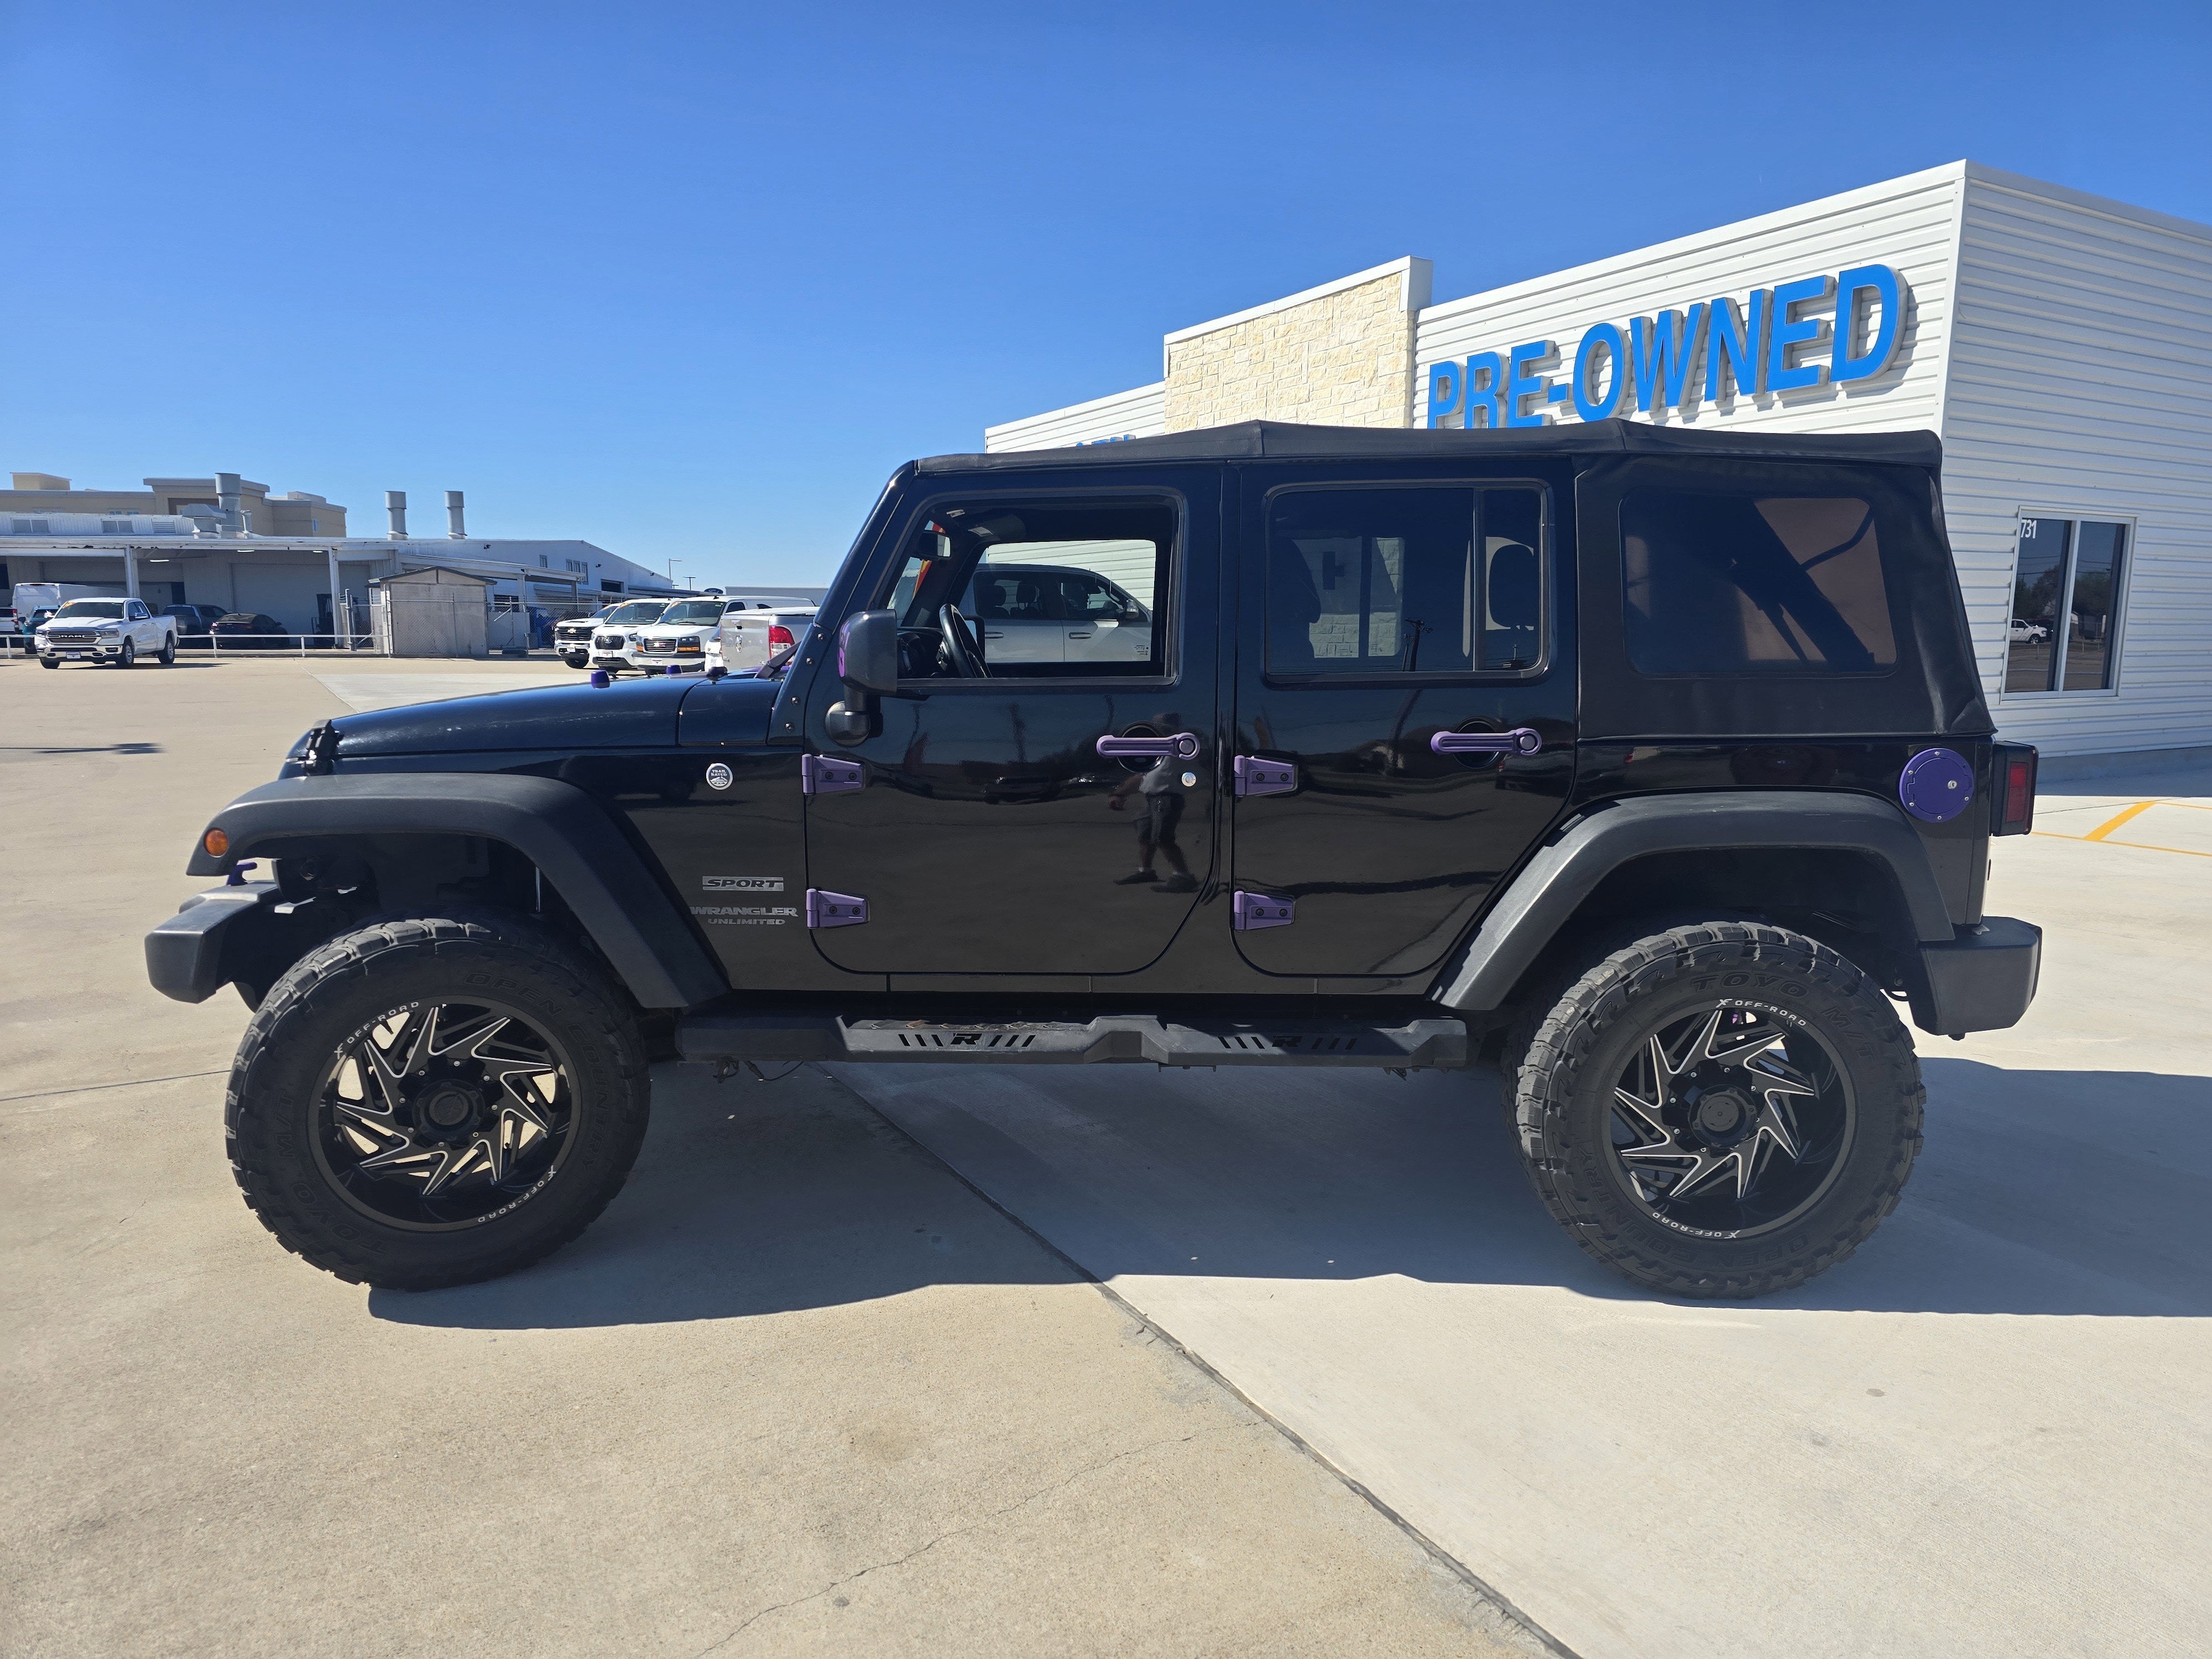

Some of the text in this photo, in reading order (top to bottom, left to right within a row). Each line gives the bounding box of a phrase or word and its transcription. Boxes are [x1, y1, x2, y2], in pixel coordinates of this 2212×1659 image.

[1428, 264, 1907, 429] PRE-OWNED
[2021, 519, 2037, 539] 731
[707, 879, 784, 888] SPORT
[689, 906, 799, 917] WRANGLER
[463, 972, 565, 1016] OPEN
[1735, 1000, 1806, 1026] OFF-ROAD
[347, 1001, 419, 1044] OFF-ROAD
[1691, 971, 1810, 998] TOYO
[1822, 1006, 1878, 1062] M/T
[566, 1023, 611, 1172] COUNTRY
[477, 1180, 545, 1223] OFF-ROAD
[1652, 1212, 1722, 1238] OFF-ROAD
